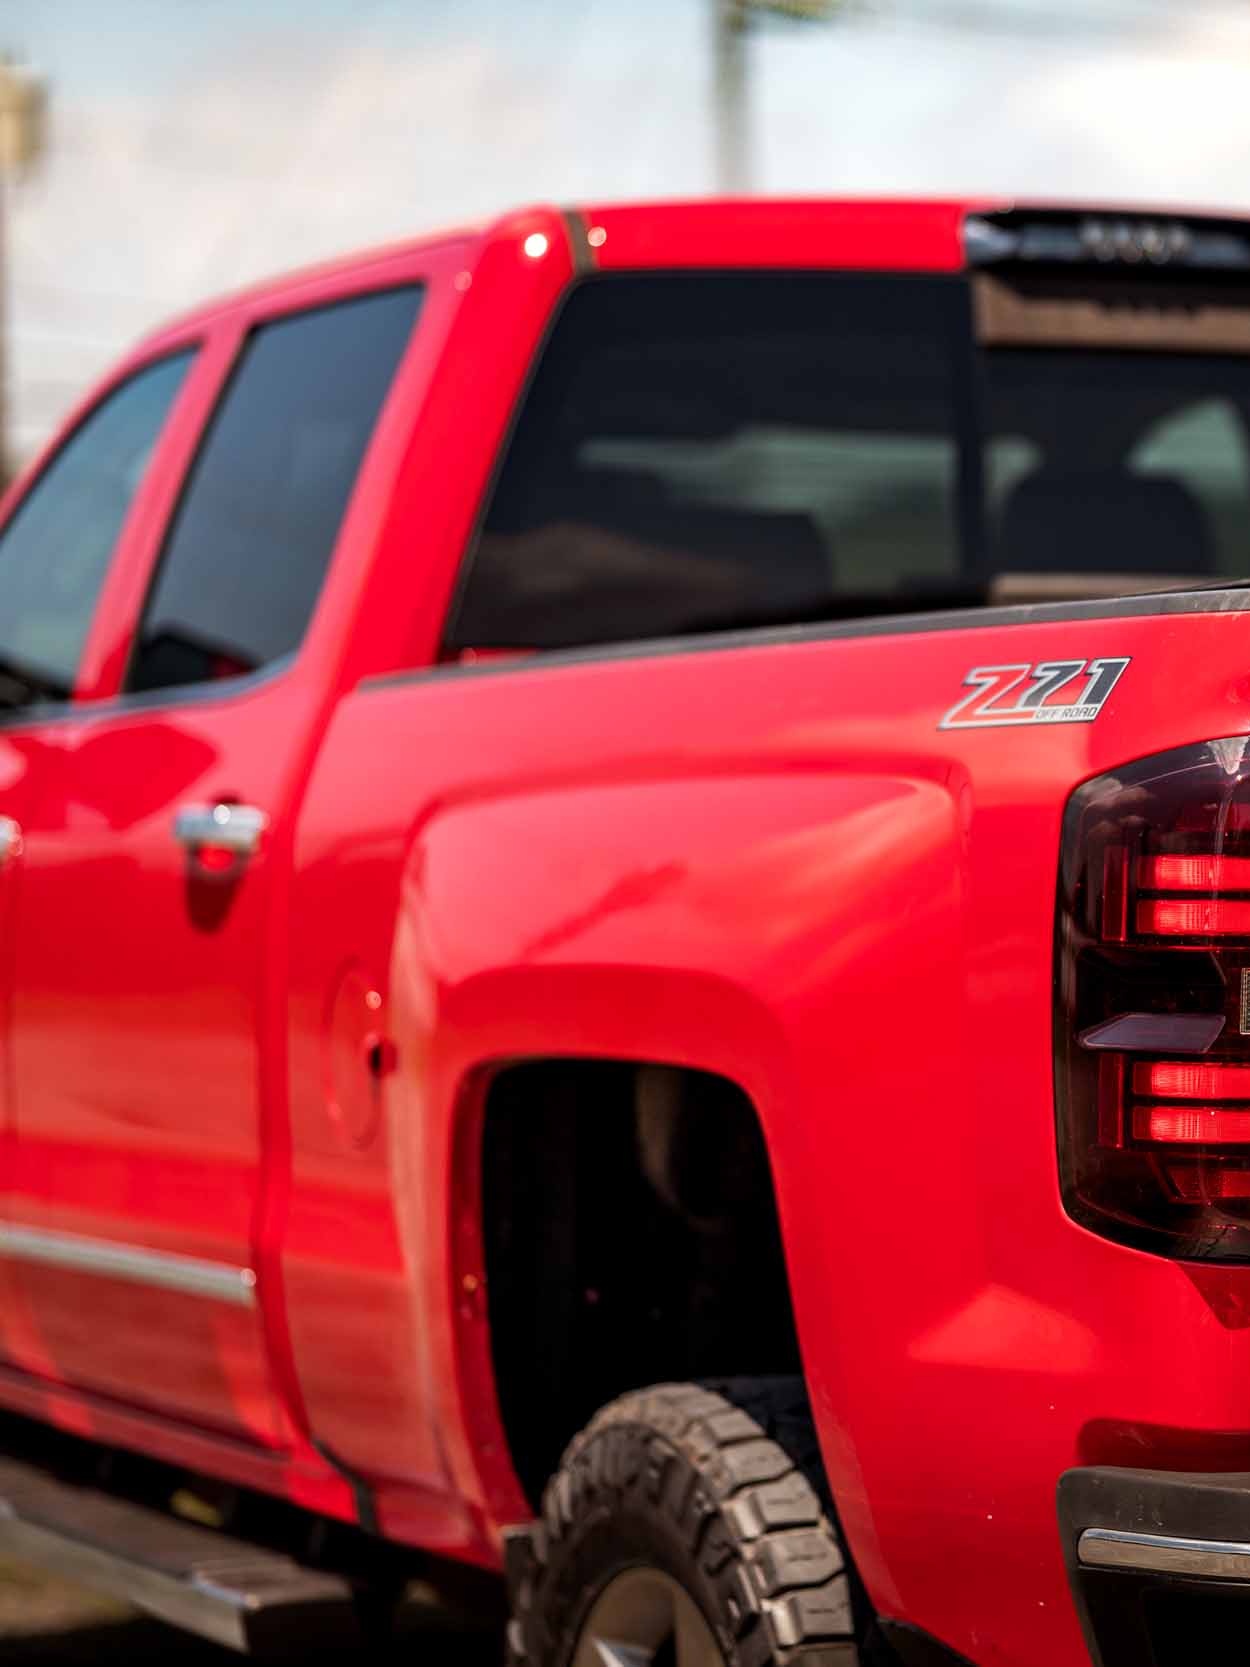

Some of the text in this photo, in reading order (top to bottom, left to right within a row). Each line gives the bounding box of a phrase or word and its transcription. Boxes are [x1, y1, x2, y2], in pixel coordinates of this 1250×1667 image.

[938, 657, 1132, 729] Z71
[1036, 706, 1098, 719] OFF ROAD
